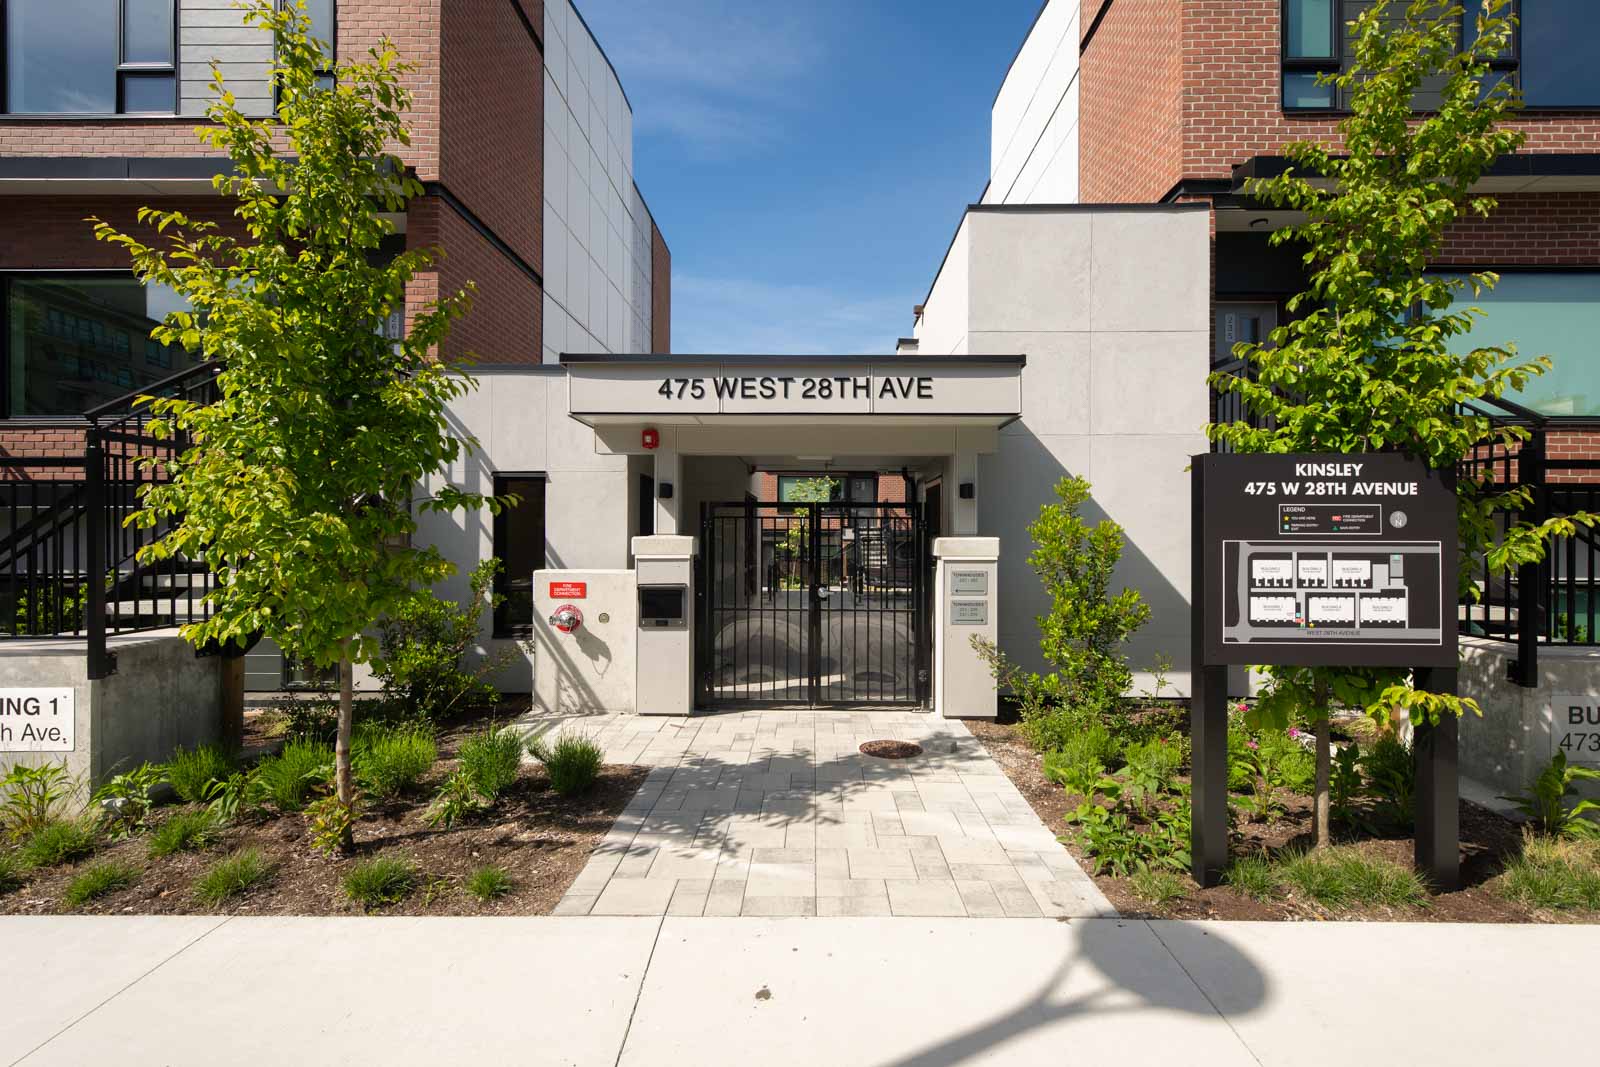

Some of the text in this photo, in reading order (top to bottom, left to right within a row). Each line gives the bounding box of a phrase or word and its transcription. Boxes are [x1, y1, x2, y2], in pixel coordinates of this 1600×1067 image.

[658, 377, 934, 399] 475 WEST 28TH AVE
[1296, 463, 1363, 476] KINSLEY
[1244, 482, 1418, 495] 475 W 28TH AVENUE
[0, 697, 57, 716] ING 1
[21, 723, 67, 741] Ave.
[1560, 732, 1600, 752] 473
